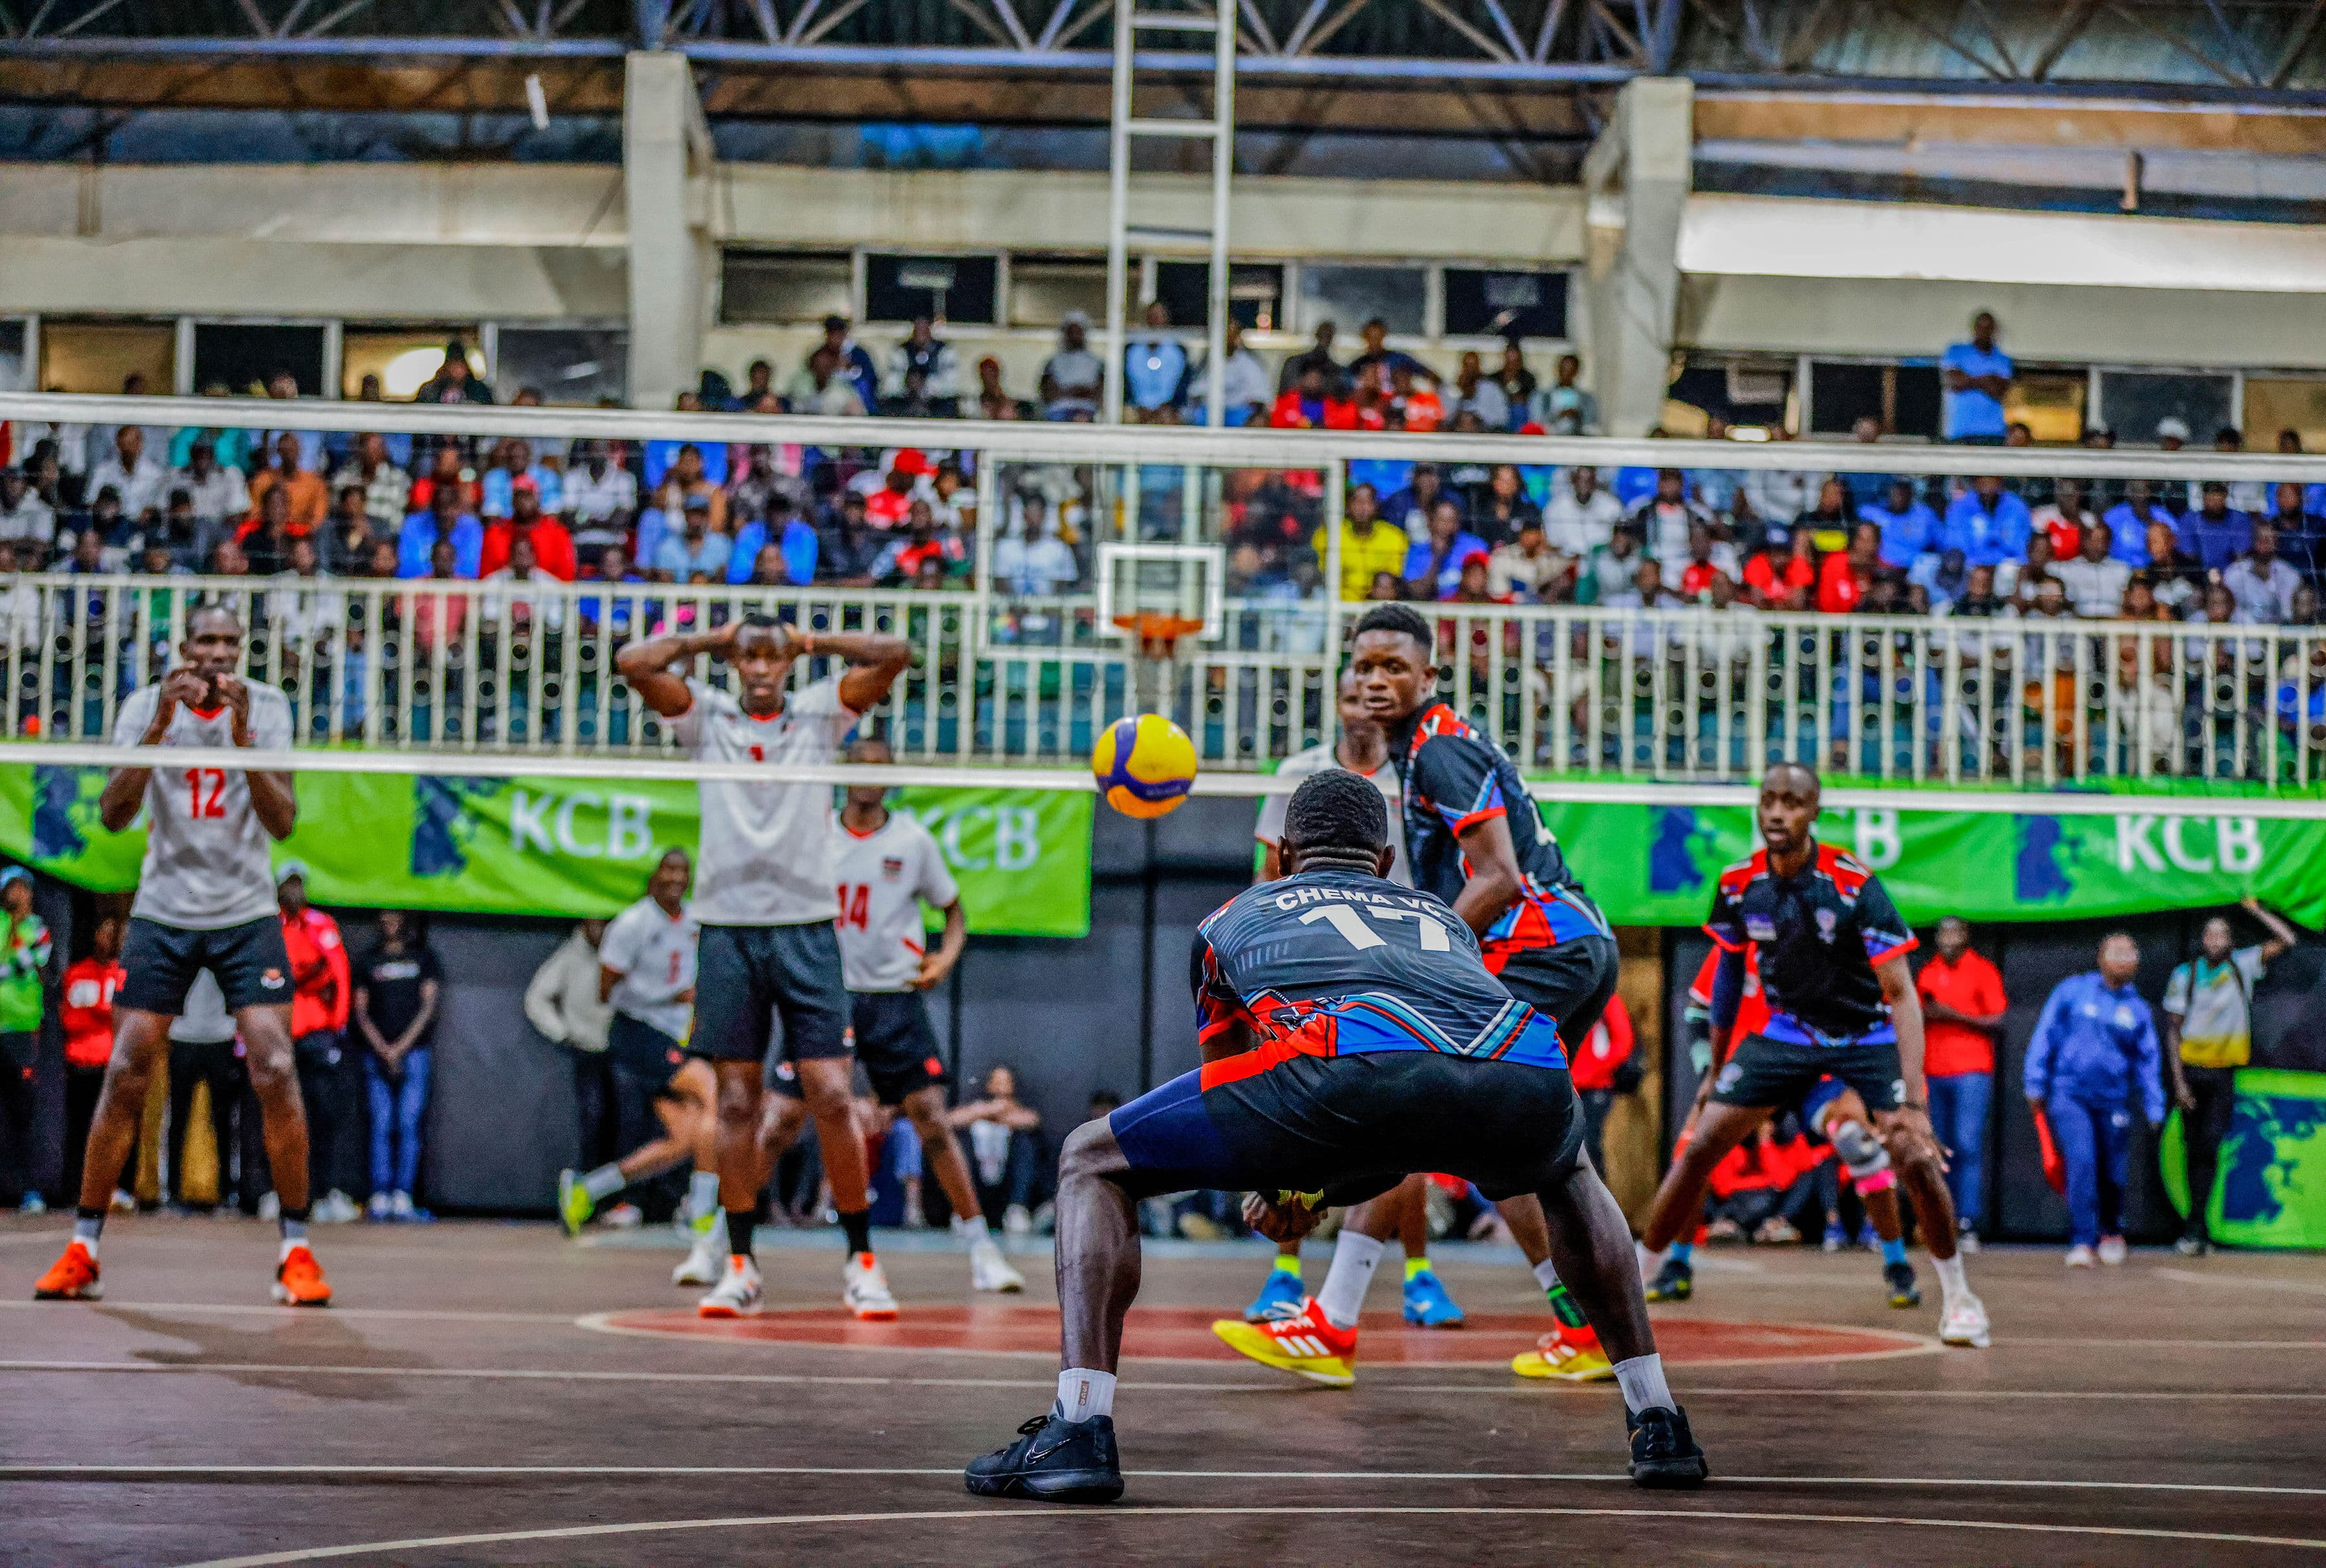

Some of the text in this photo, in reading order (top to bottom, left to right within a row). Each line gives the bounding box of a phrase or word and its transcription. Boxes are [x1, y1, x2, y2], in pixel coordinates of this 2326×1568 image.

[185, 767, 226, 819] 12
[510, 790, 653, 860] KCB
[2115, 814, 2263, 872] KCB
[835, 883, 870, 932] 14
[1275, 888, 1442, 917] CHEMA VC
[1298, 904, 1450, 952] 17
